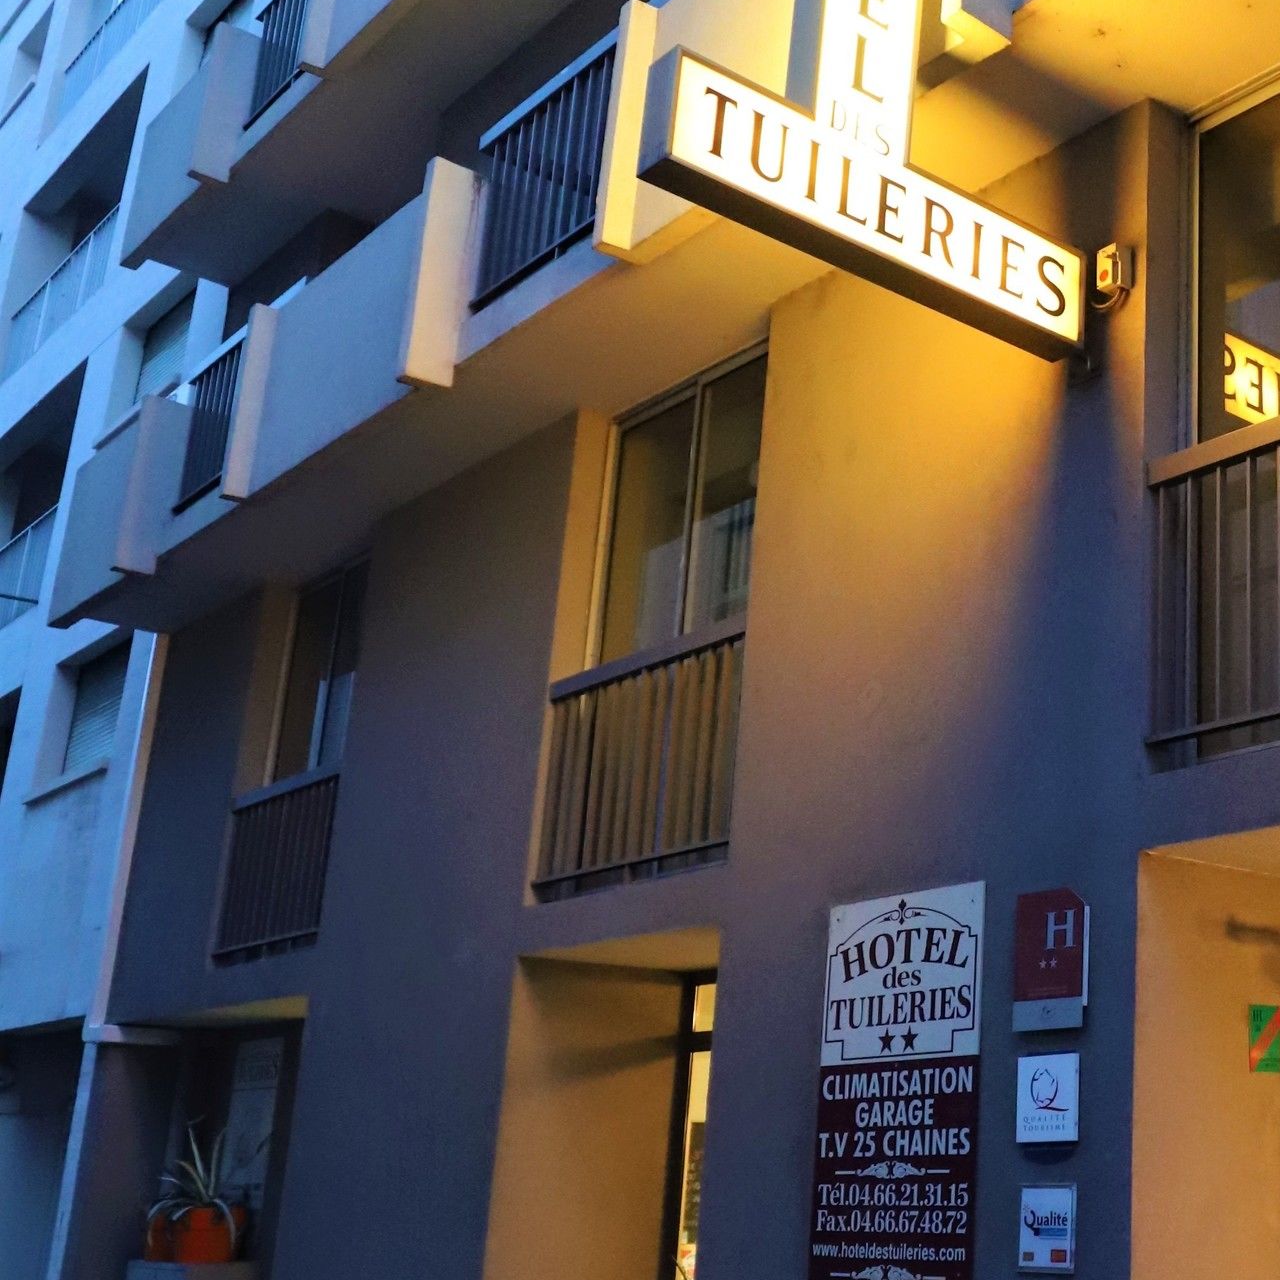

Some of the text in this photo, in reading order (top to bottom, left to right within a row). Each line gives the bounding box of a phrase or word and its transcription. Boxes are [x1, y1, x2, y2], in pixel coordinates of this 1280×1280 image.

[704, 87, 1067, 317] TUILERIES
[1046, 909, 1076, 949] H
[840, 927, 969, 983] HOTEL
[882, 967, 921, 989] des
[830, 984, 972, 1031] TUILERIES
[822, 1065, 973, 1101] CLIMATISATION
[855, 1098, 935, 1128] GARAGE
[818, 1127, 971, 1158] T.V 25 CHAINES
[817, 1182, 969, 1207] Tél.04.66.21.31.15
[816, 1209, 968, 1234] Fax.04.66.67.48.72
[1024, 1210, 1068, 1230] Qualité
[812, 1241, 966, 1262] www.hoteldestuileries.com
